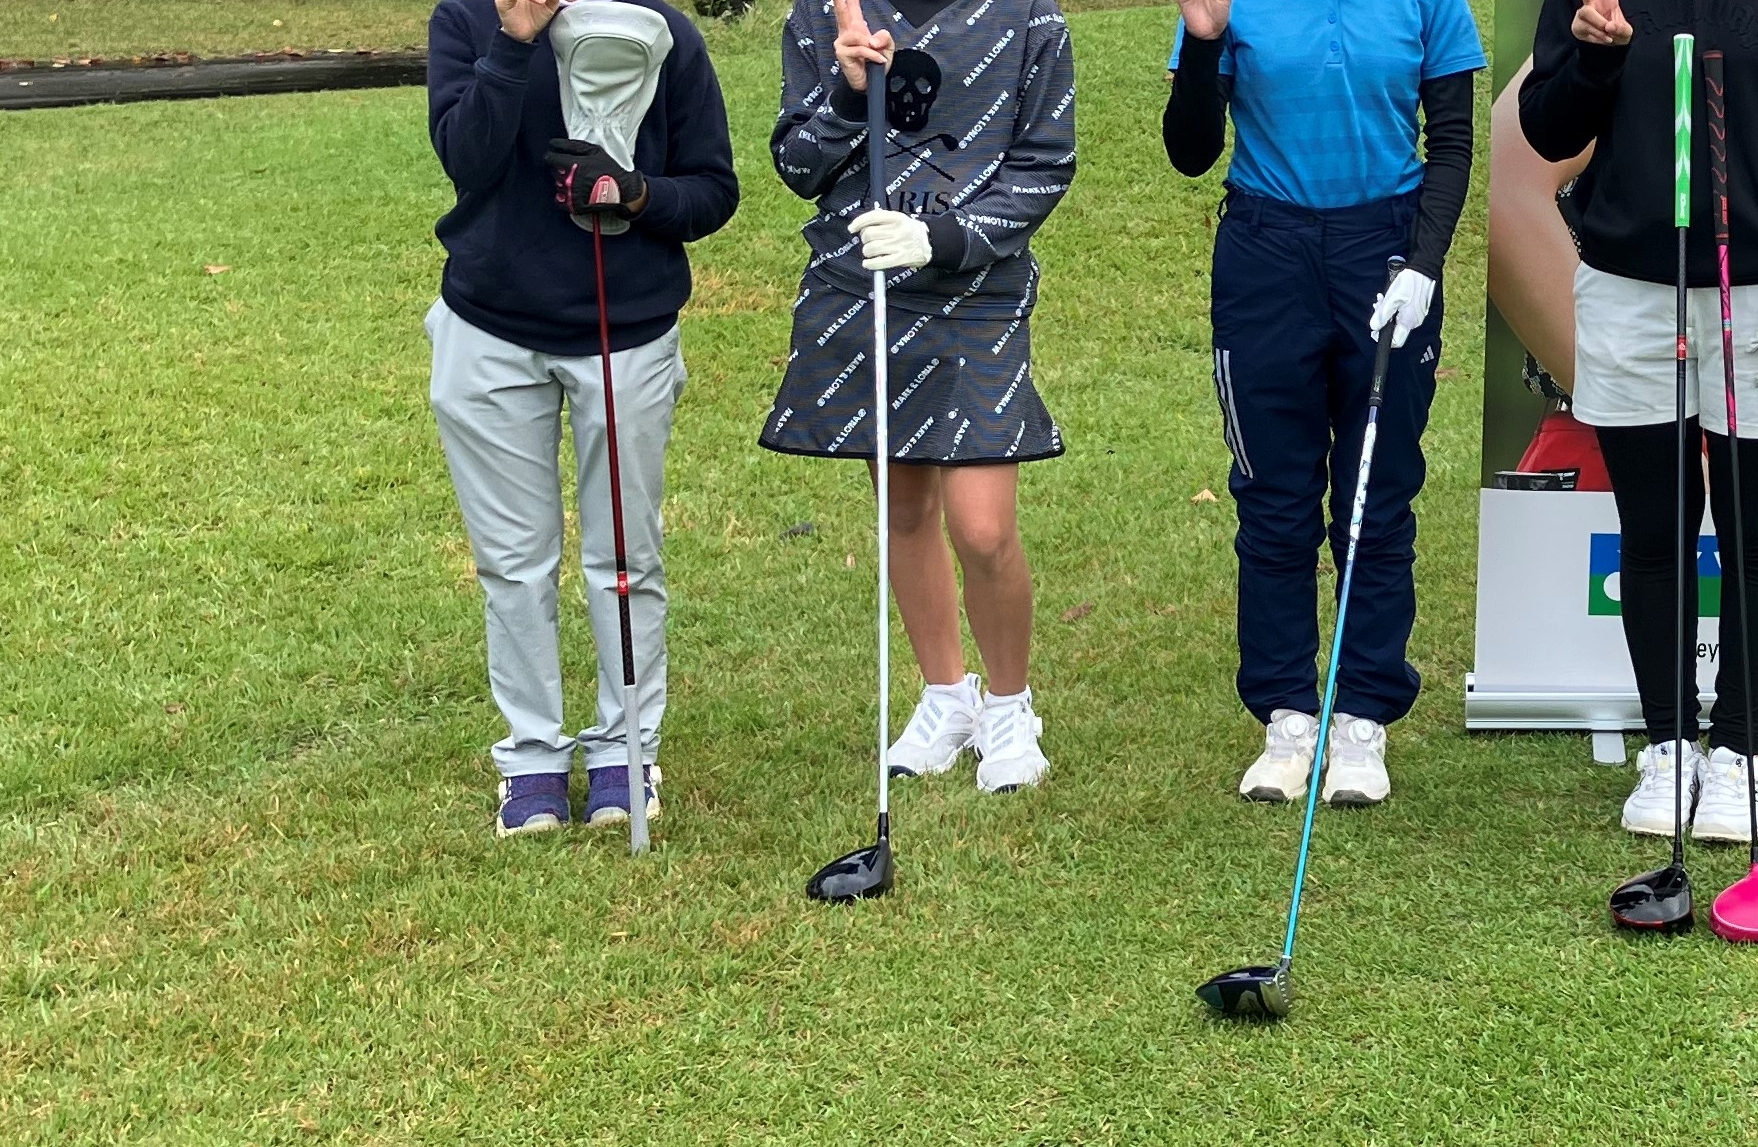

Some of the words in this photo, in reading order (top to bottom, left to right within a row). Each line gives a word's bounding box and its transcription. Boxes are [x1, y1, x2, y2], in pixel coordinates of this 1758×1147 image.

[916, 24, 940, 50] MARK
[963, 62, 988, 87] MARK
[987, 90, 1009, 116] MARK
[1052, 93, 1073, 120] MARK
[952, 183, 977, 206] MARK
[817, 323, 841, 347] MARK
[843, 300, 867, 320] LONA
[992, 331, 1011, 355] MARK
[844, 352, 865, 374] MARK
[892, 387, 914, 410] MARK
[914, 416, 934, 439] MARK
